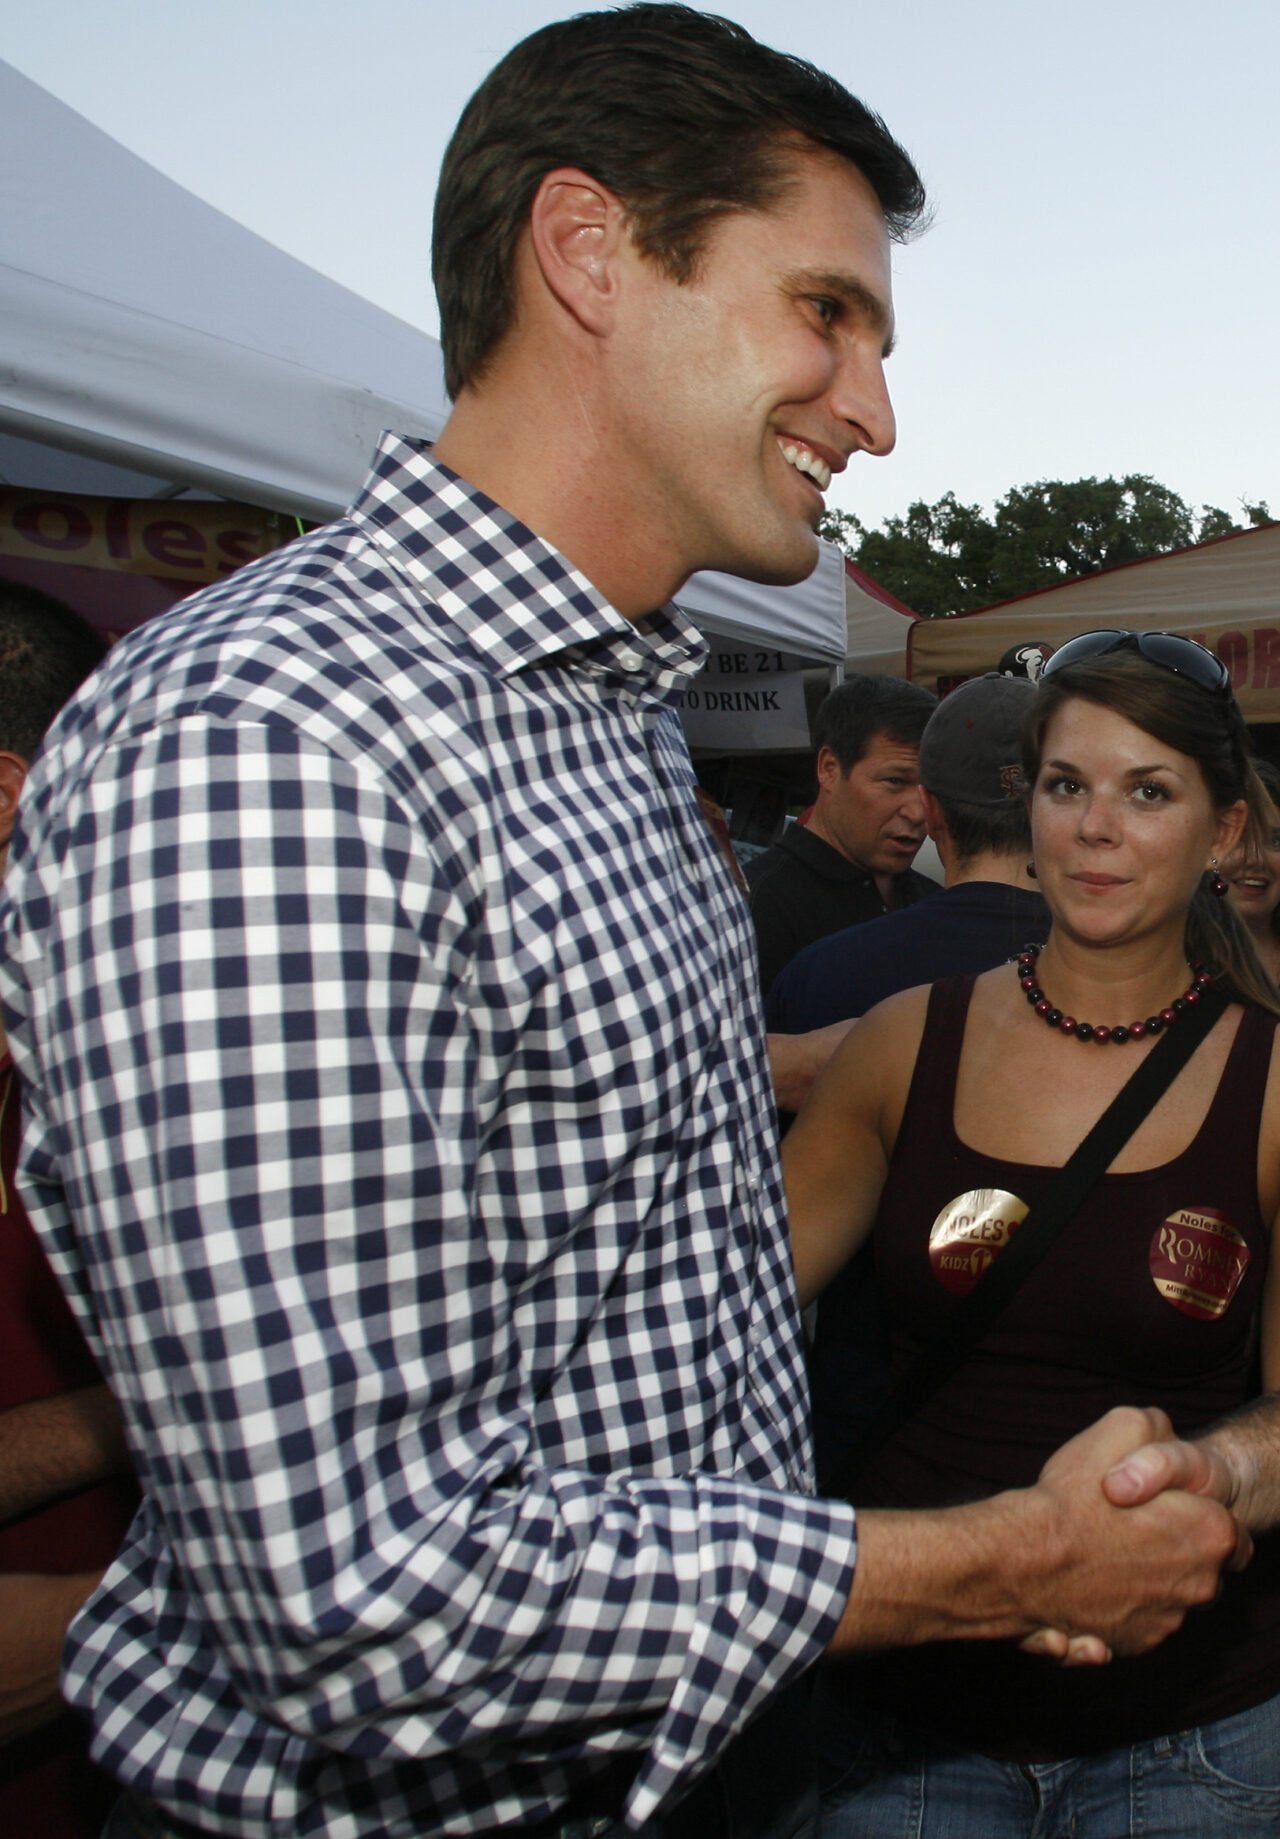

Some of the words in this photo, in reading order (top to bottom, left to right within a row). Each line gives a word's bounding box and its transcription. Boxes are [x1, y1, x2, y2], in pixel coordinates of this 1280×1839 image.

[718, 653, 749, 674] BE
[755, 651, 787, 673] 21
[703, 689, 782, 712] DRINK
[1179, 1213, 1218, 1232] Noles
[1158, 1226, 1249, 1276] ROMNEY
[940, 1255, 969, 1271] KIDZ
